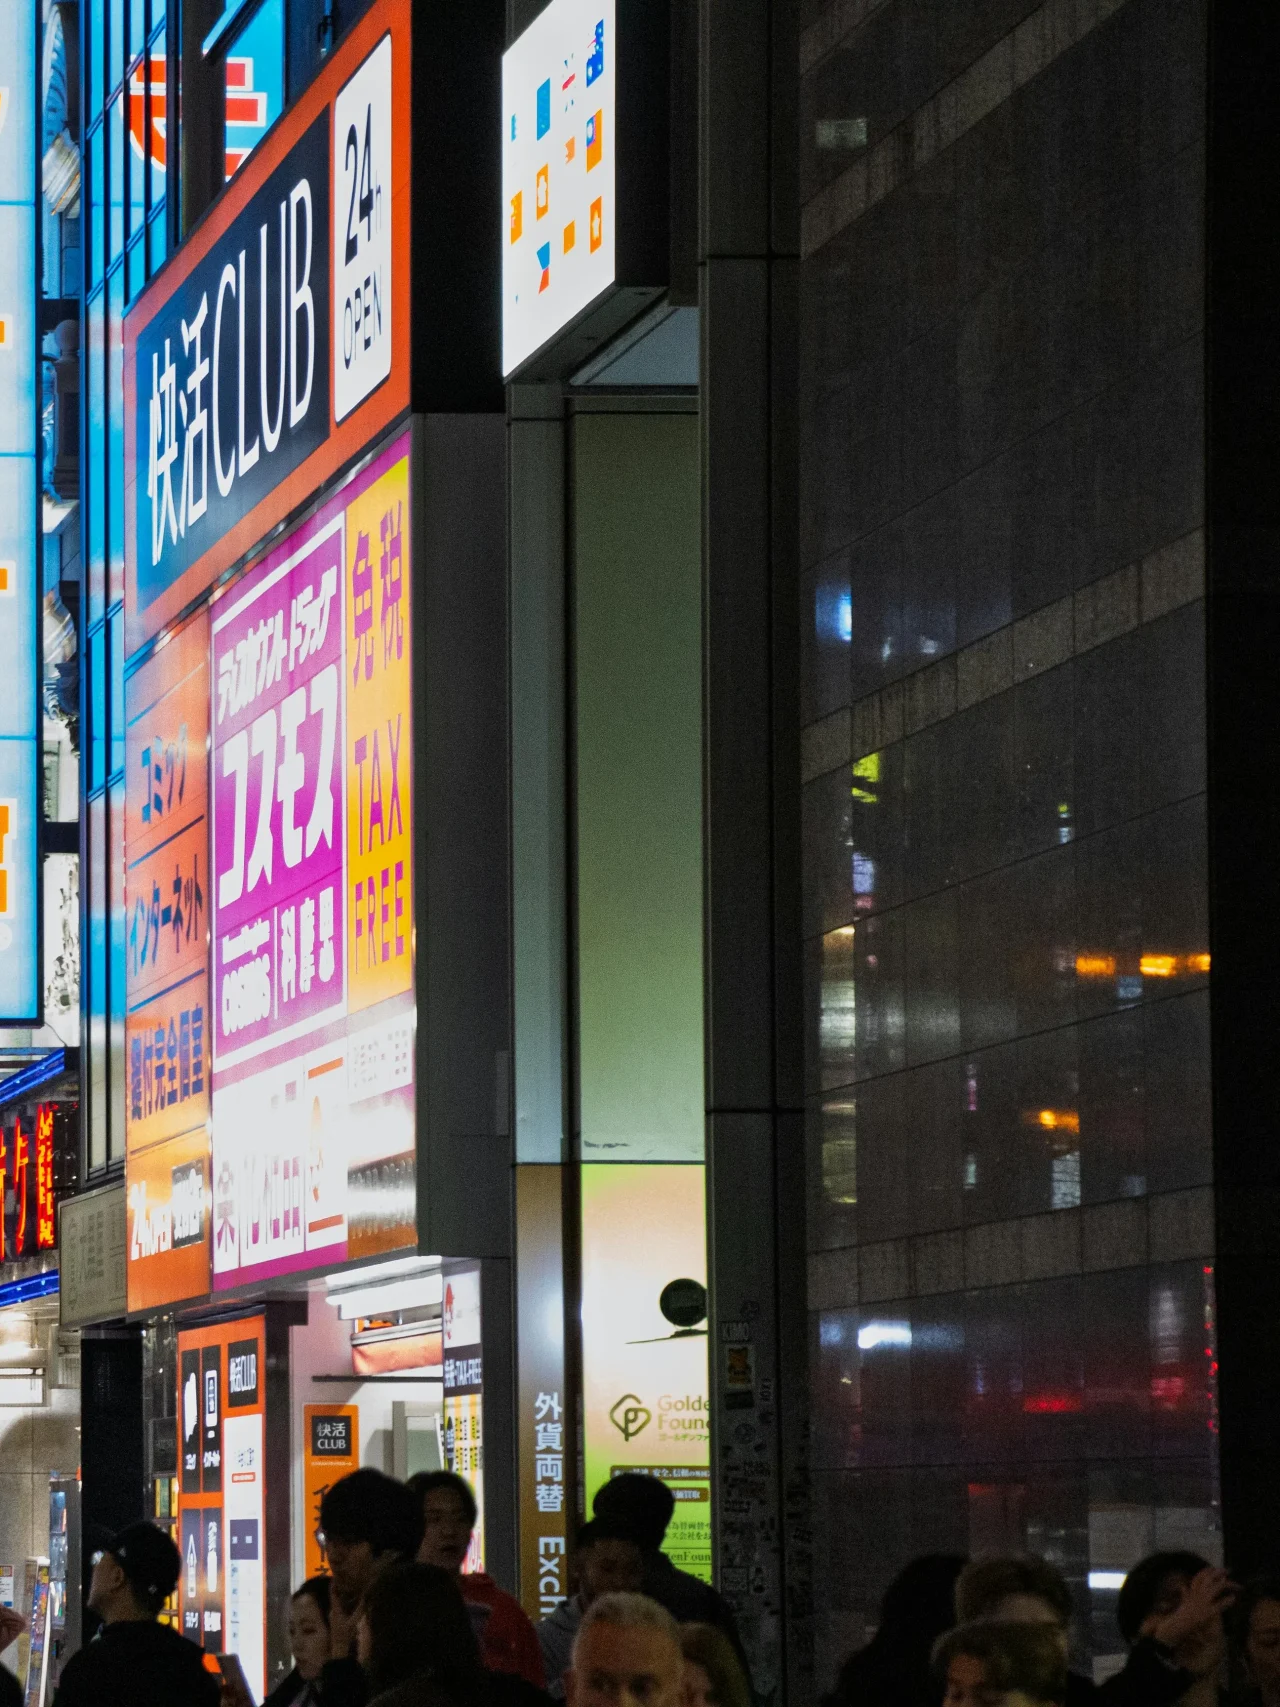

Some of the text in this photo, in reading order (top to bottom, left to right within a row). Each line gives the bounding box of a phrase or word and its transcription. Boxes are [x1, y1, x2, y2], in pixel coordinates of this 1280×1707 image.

[148, 178, 316, 567] 快活CLUB
[344, 263, 382, 370] OPEN
[352, 500, 404, 687] 免税
[219, 663, 337, 908] コスモス
[354, 712, 404, 857] TAX
[354, 860, 404, 975] FREE
[317, 1422, 346, 1437] 快活
[317, 1438, 346, 1449] CLUB
[535, 1392, 564, 1512] 外貨両替
